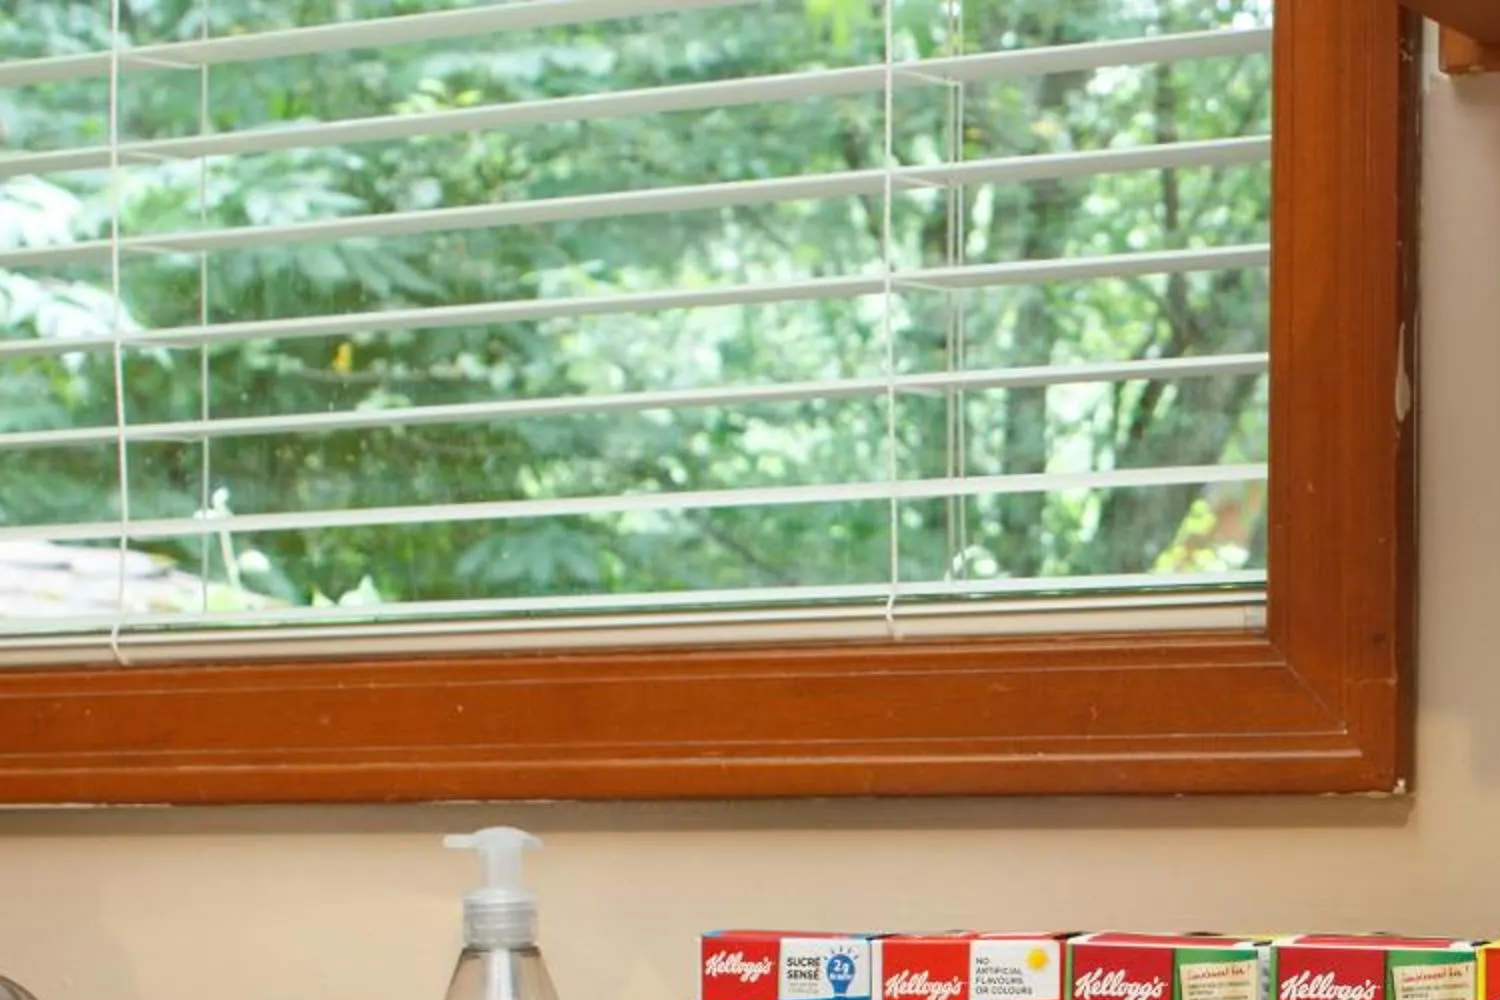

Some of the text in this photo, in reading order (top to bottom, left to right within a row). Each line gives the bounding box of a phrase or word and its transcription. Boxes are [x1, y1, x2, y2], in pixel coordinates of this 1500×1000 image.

[786, 957, 821, 967] SUCRE
[975, 956, 989, 965] NO
[704, 950, 773, 983] Kellogg's
[975, 986, 1033, 995] OR COLOURS
